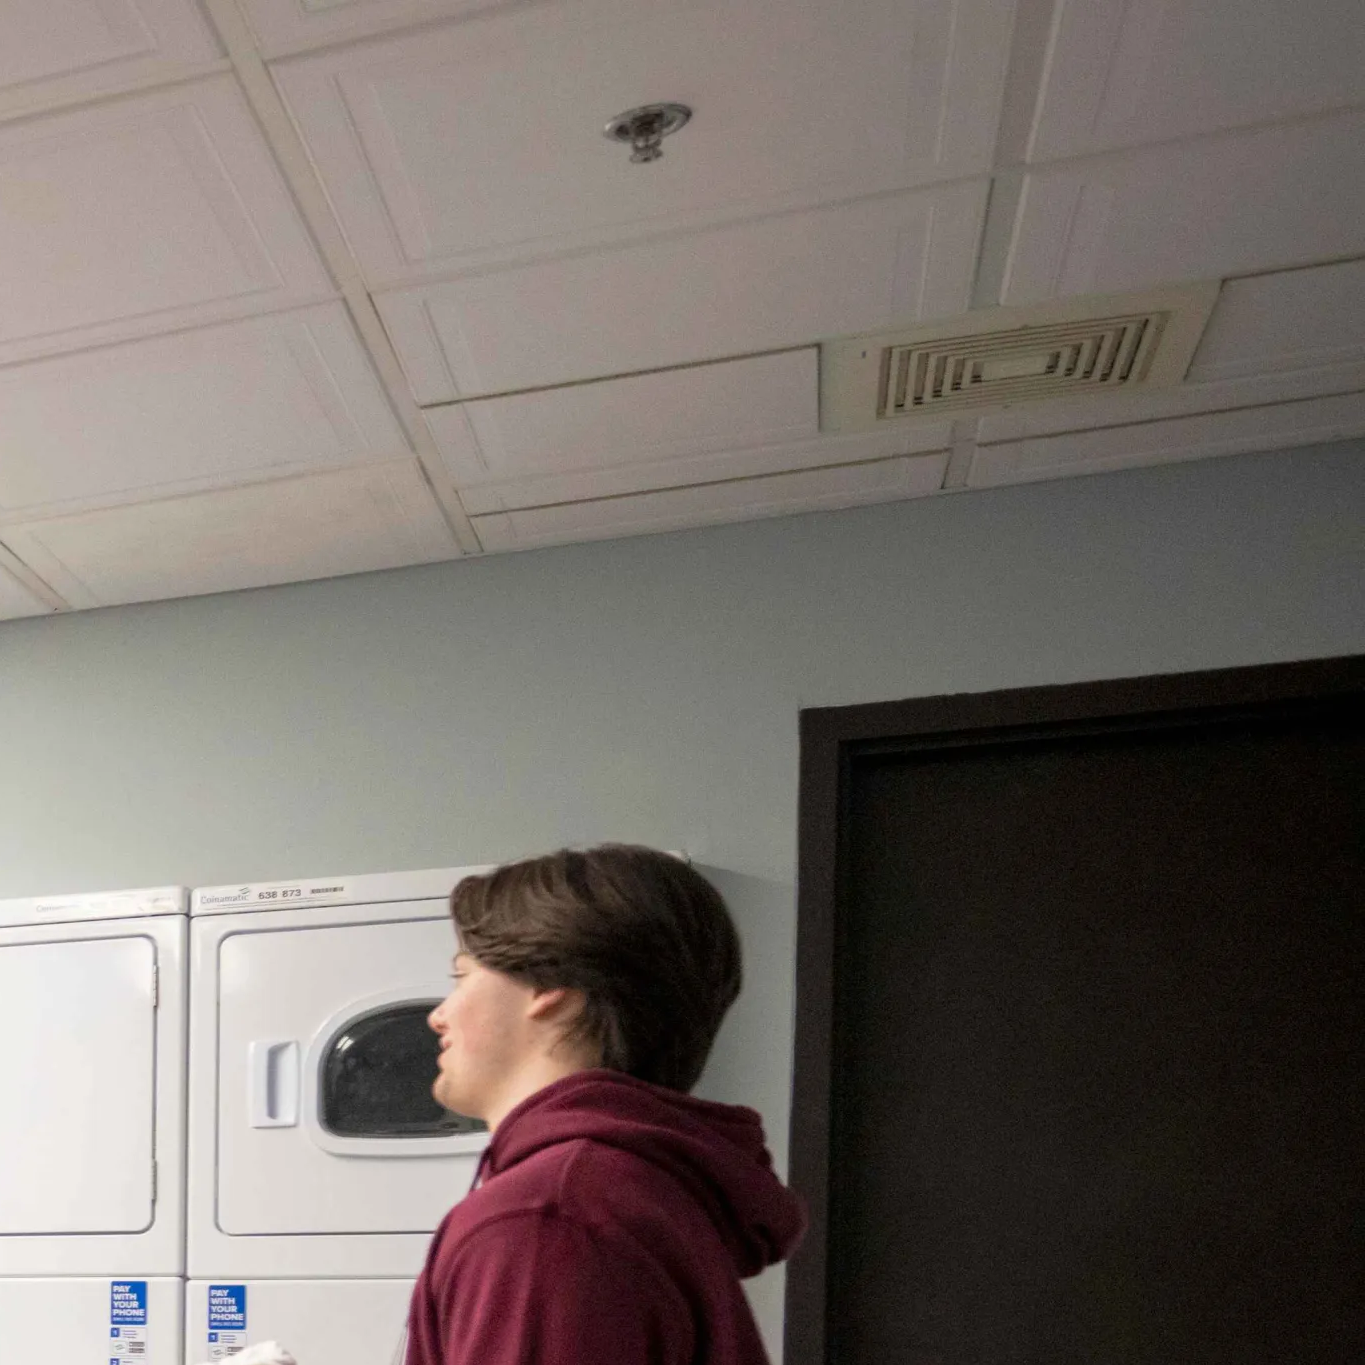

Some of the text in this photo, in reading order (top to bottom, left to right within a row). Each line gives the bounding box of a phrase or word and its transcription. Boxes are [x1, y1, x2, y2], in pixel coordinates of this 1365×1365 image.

[258, 890, 278, 900] 638
[281, 889, 302, 898] 873
[112, 1285, 132, 1293] PAY
[210, 1289, 230, 1297] PAY
[113, 1301, 140, 1309] YOUR
[210, 1297, 236, 1305] WITH
[112, 1308, 145, 1317] PHONE
[210, 1305, 238, 1313] YOUR
[210, 1313, 244, 1321] PHONE
